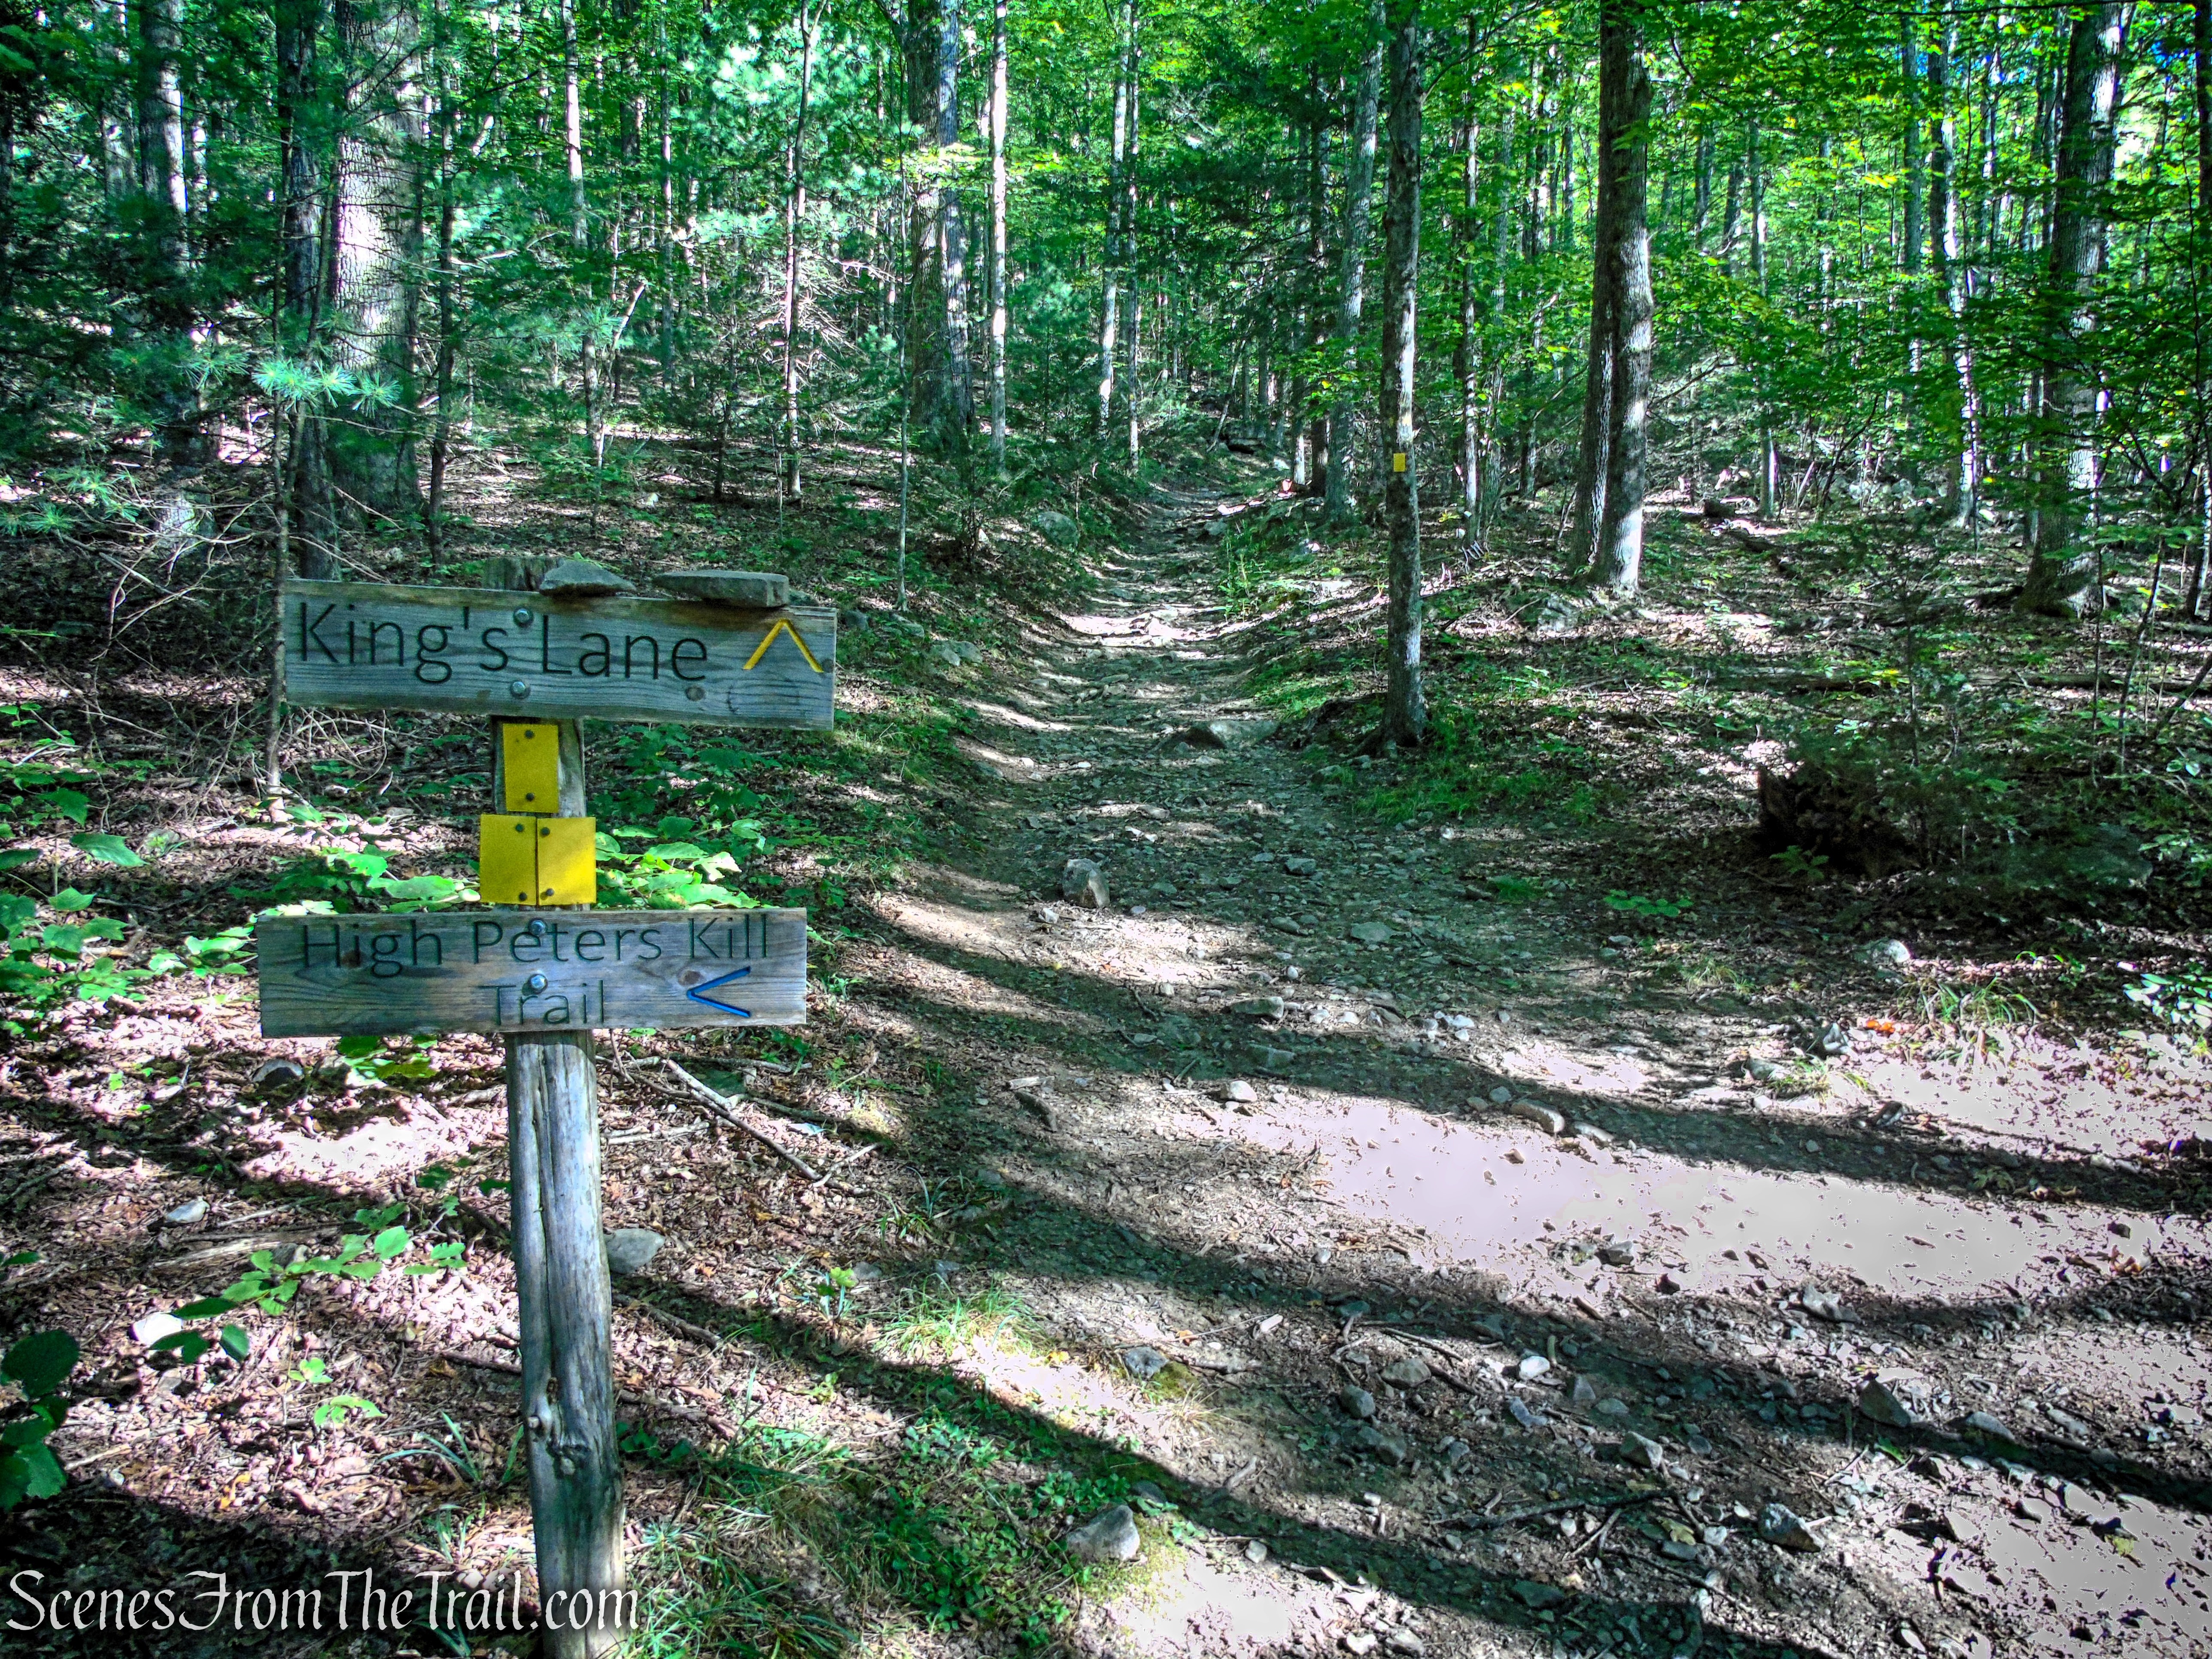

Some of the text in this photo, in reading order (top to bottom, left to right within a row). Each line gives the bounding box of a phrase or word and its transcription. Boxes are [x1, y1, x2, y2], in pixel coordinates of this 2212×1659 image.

[300, 601, 708, 684] King's Lane
[302, 914, 768, 979] High Peters Kill
[480, 979, 604, 1026] Trail
